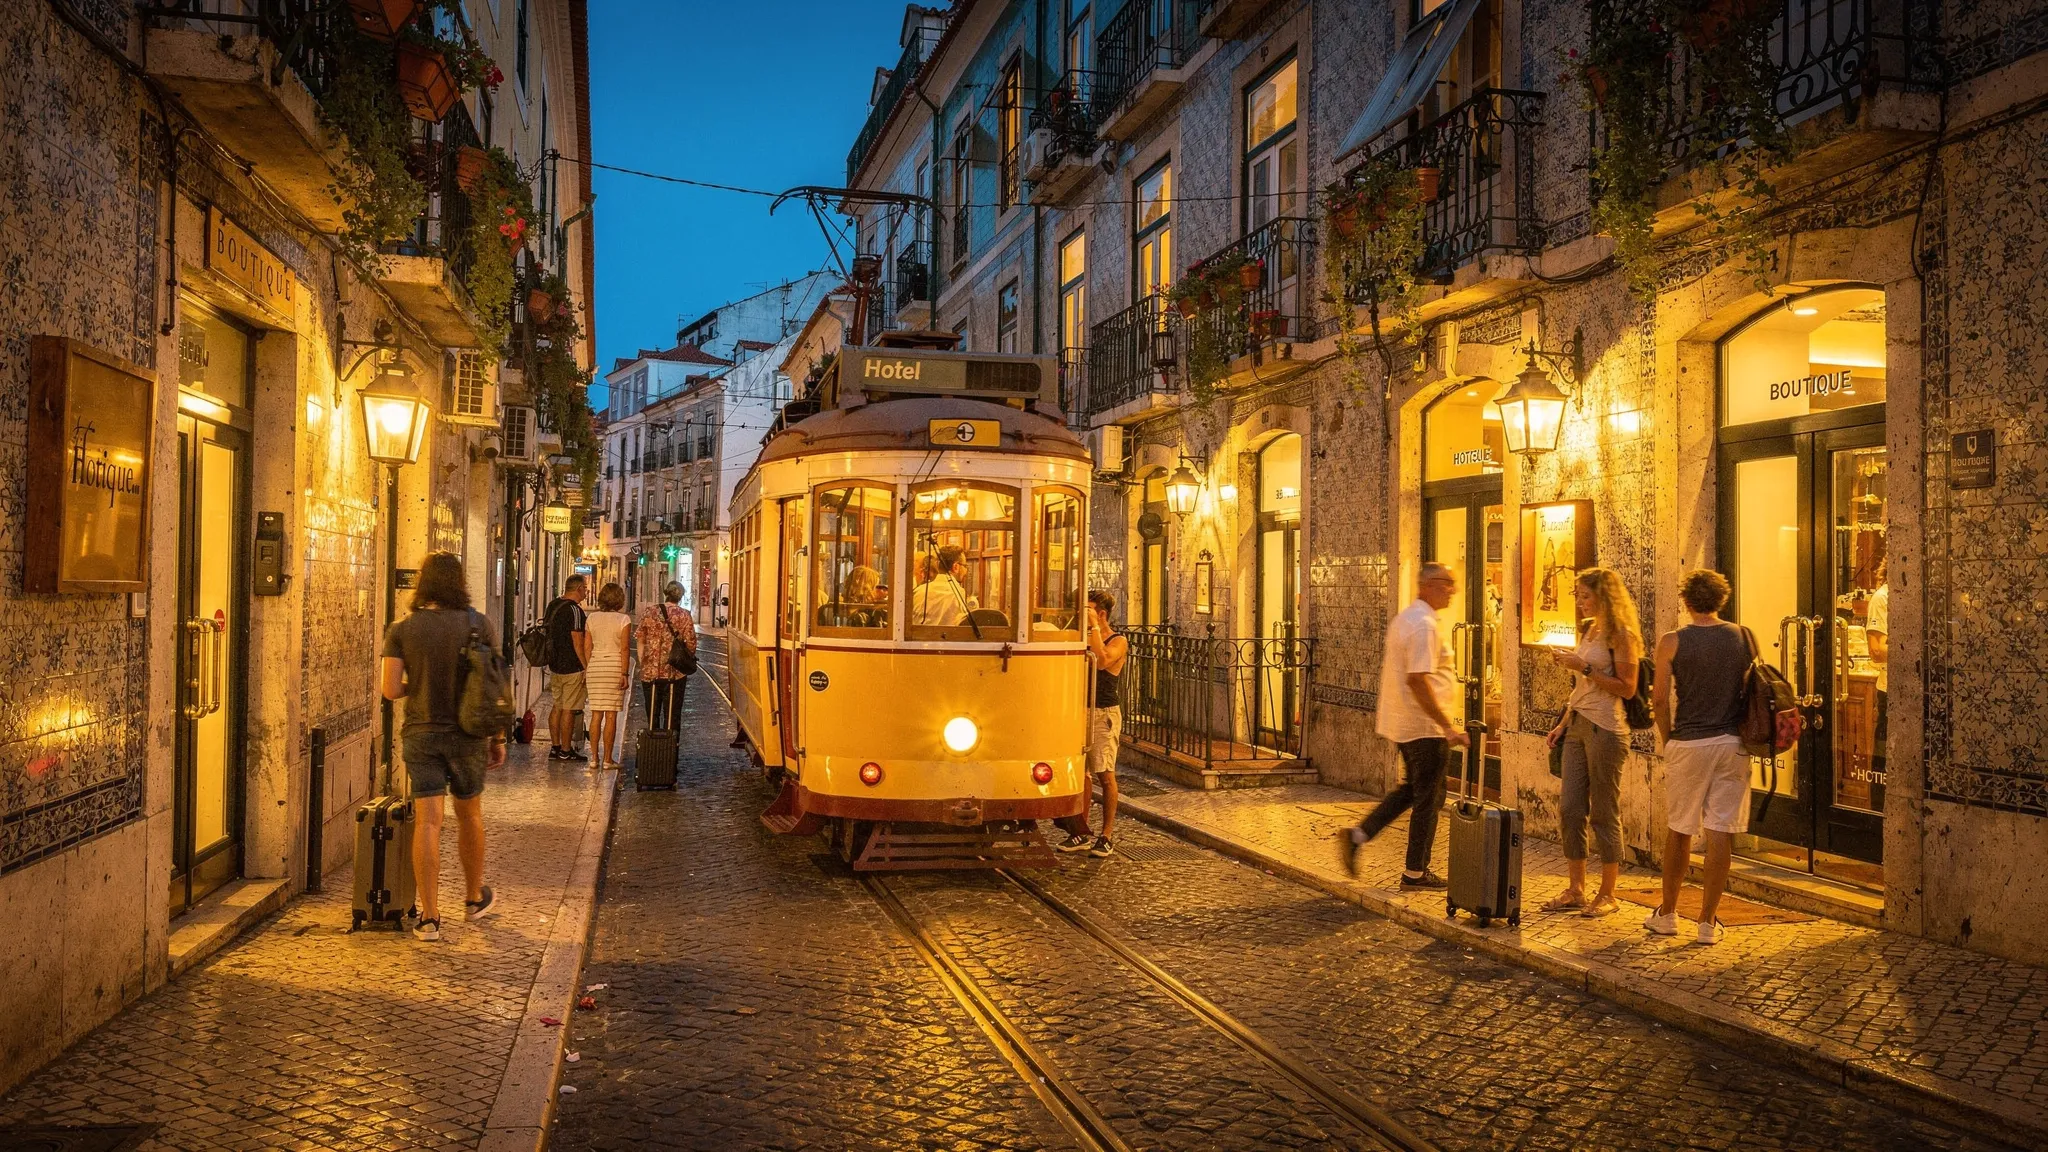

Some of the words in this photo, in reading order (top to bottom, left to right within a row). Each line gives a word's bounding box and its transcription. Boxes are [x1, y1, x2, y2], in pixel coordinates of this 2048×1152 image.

[217, 228, 291, 301] BOUTIQUE
[864, 359, 921, 380] Hotel
[1770, 370, 1852, 400] BOUTIQUE
